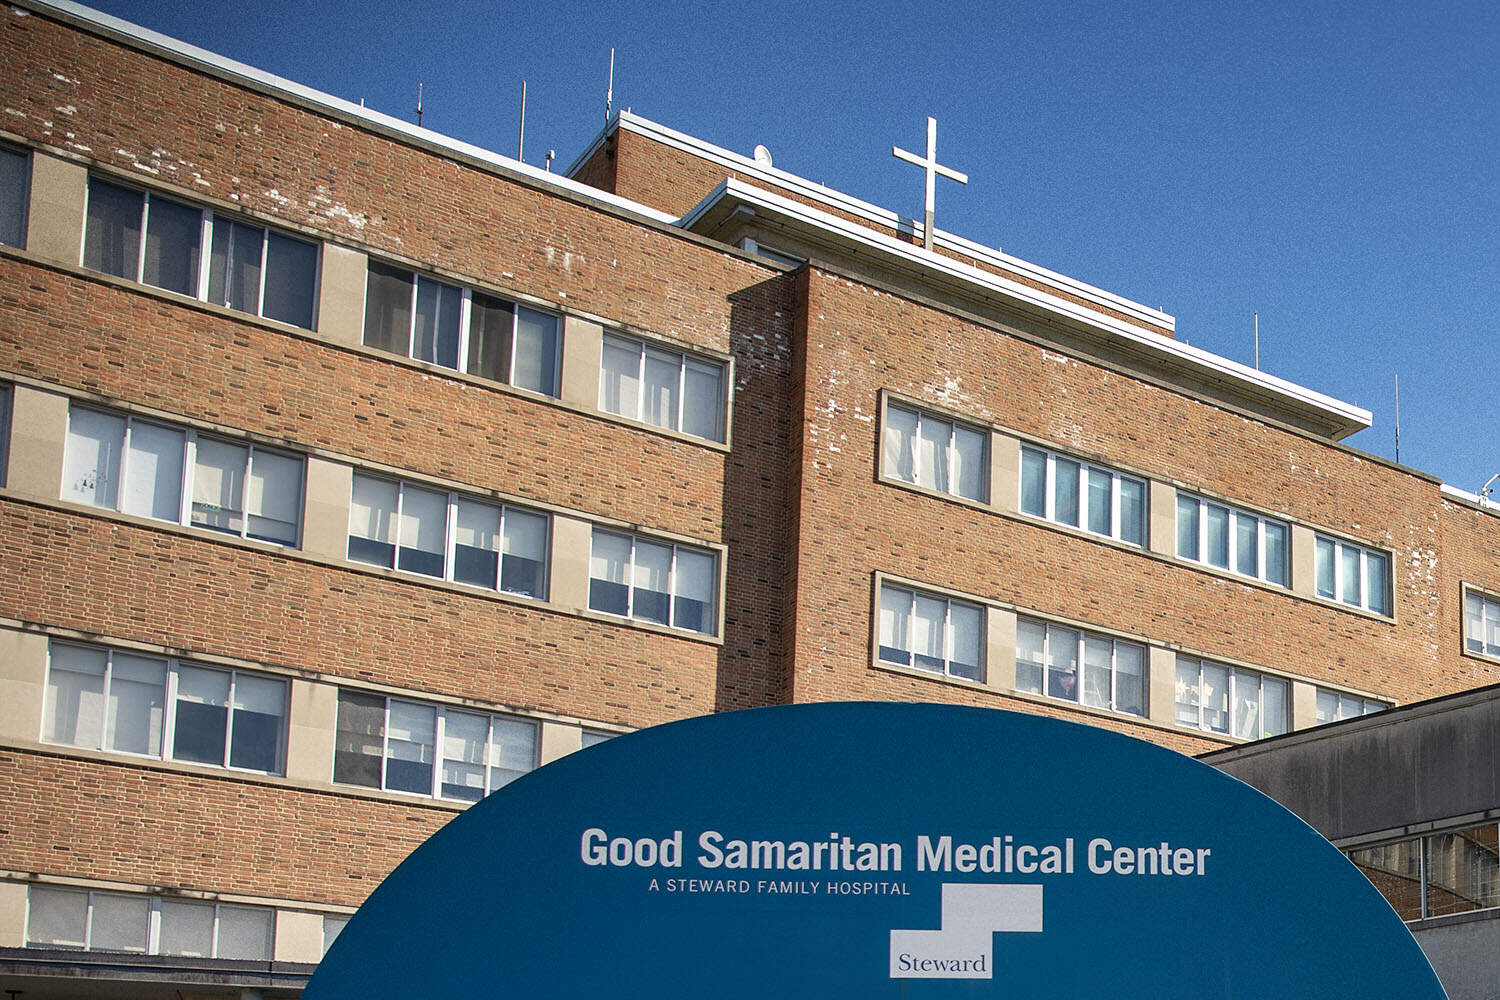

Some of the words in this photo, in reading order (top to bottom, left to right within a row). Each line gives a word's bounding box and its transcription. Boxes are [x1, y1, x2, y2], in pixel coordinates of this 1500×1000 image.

[580, 827, 683, 868] Good
[697, 830, 902, 872] Samaritan
[916, 834, 1074, 874] Medical
[1087, 837, 1212, 876] Center
[648, 878, 660, 892] A
[666, 878, 750, 894] STEWARD
[757, 880, 820, 895] FAMILY
[827, 881, 911, 896] HOSPITAL
[898, 953, 986, 972] Steward
